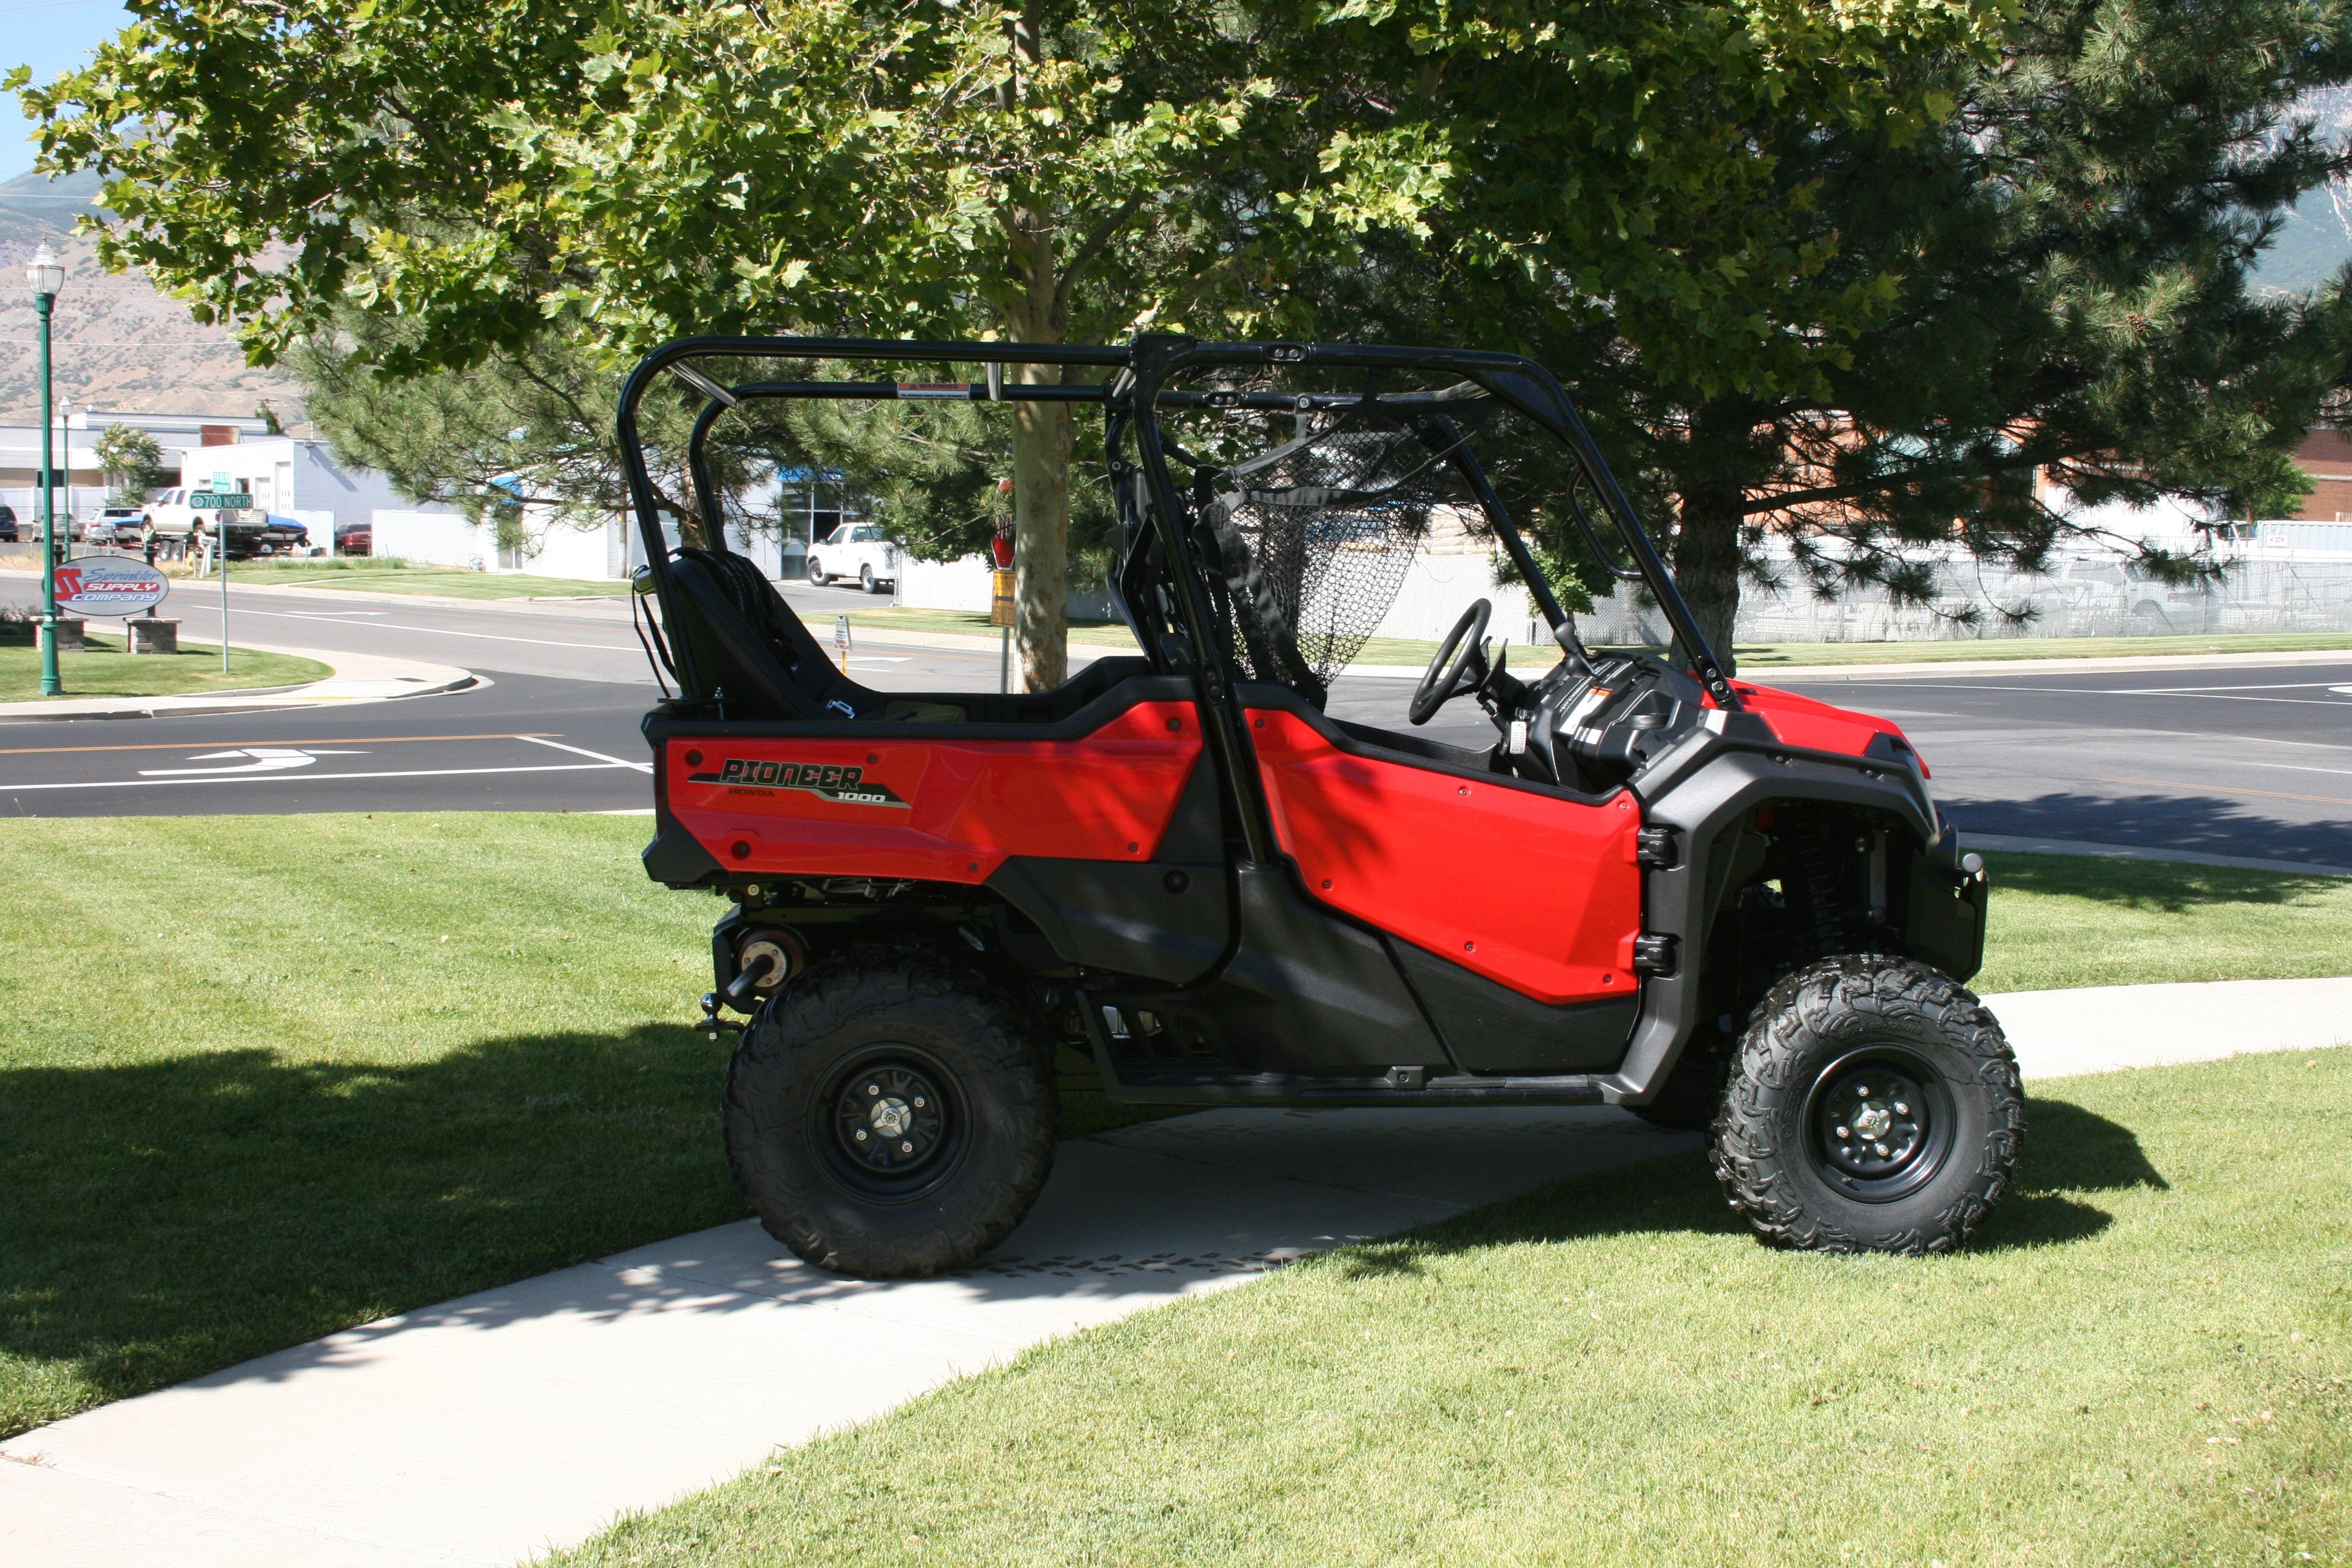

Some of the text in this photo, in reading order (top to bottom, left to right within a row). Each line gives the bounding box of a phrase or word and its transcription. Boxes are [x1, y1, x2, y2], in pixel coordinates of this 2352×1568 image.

[204, 496, 222, 508] 700
[224, 496, 252, 508] NORTH
[83, 568, 160, 583] Sprinkler
[719, 758, 864, 790] PIONEER
[728, 788, 775, 797] HONDA
[837, 791, 886, 803] 1000
